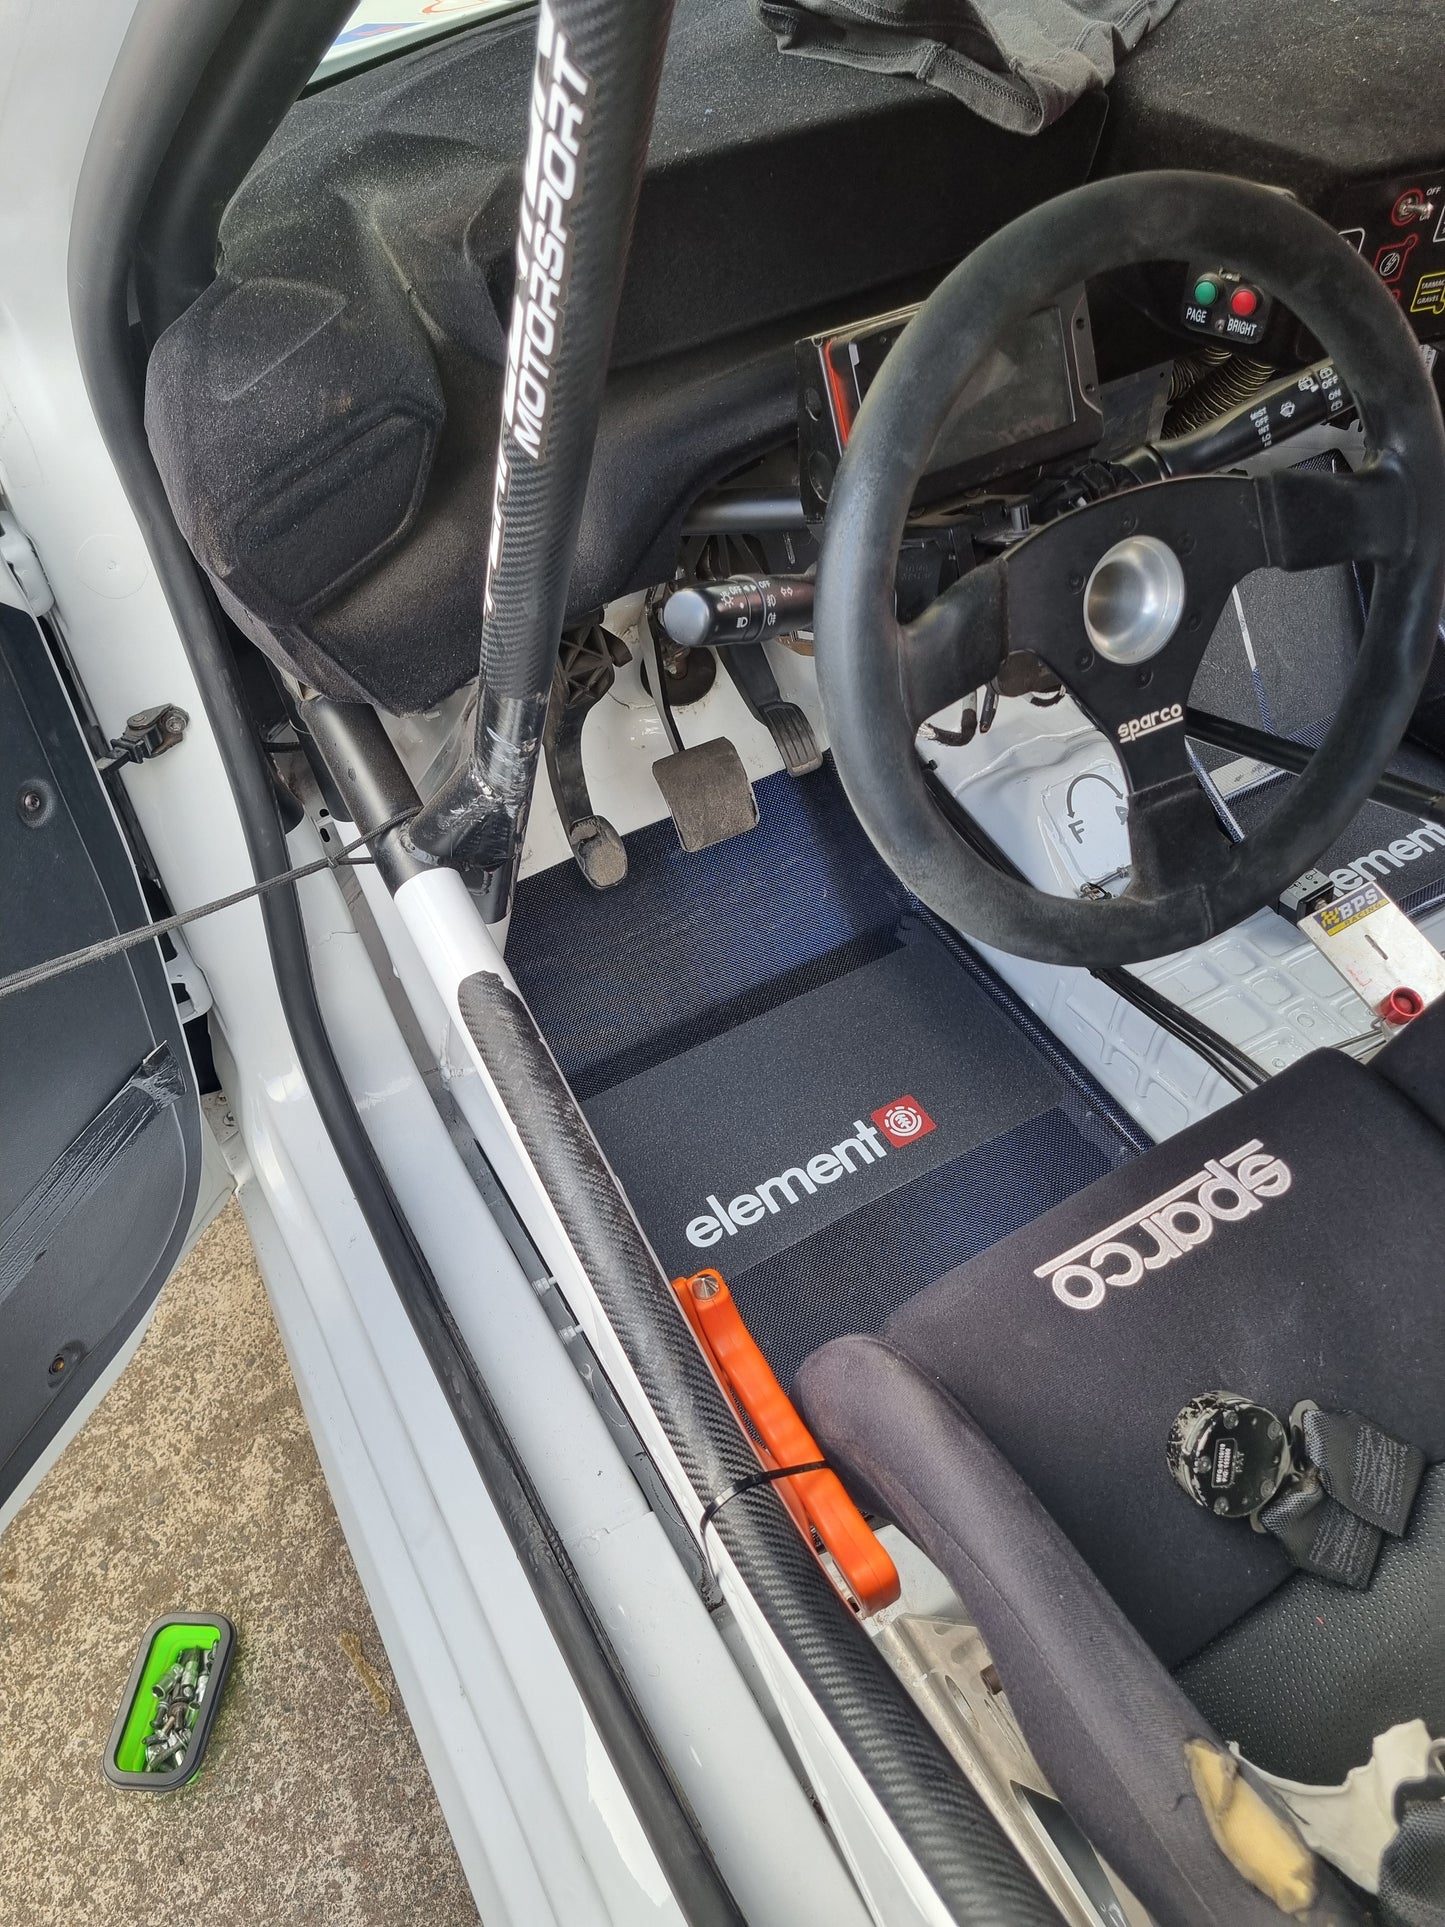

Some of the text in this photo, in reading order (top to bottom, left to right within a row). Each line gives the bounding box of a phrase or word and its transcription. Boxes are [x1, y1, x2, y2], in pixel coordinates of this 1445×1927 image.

[1426, 186, 1442, 196] OFF
[514, 31, 589, 460] MOTORSPORT
[1185, 307, 1207, 324] PAGE
[1227, 318, 1257, 337] BRIGHT
[1321, 374, 1338, 390] OFF
[1328, 388, 1342, 401] ON
[1254, 415, 1269, 428] OFF
[728, 585, 743, 595] OFF
[758, 580, 771, 589] OFF
[1118, 703, 1182, 742] sparco
[1068, 820, 1085, 844] F
[1330, 817, 1445, 898] ement
[1338, 888, 1379, 921] BPS
[685, 1119, 888, 1248] element
[1048, 1155, 1292, 1310] sparco
